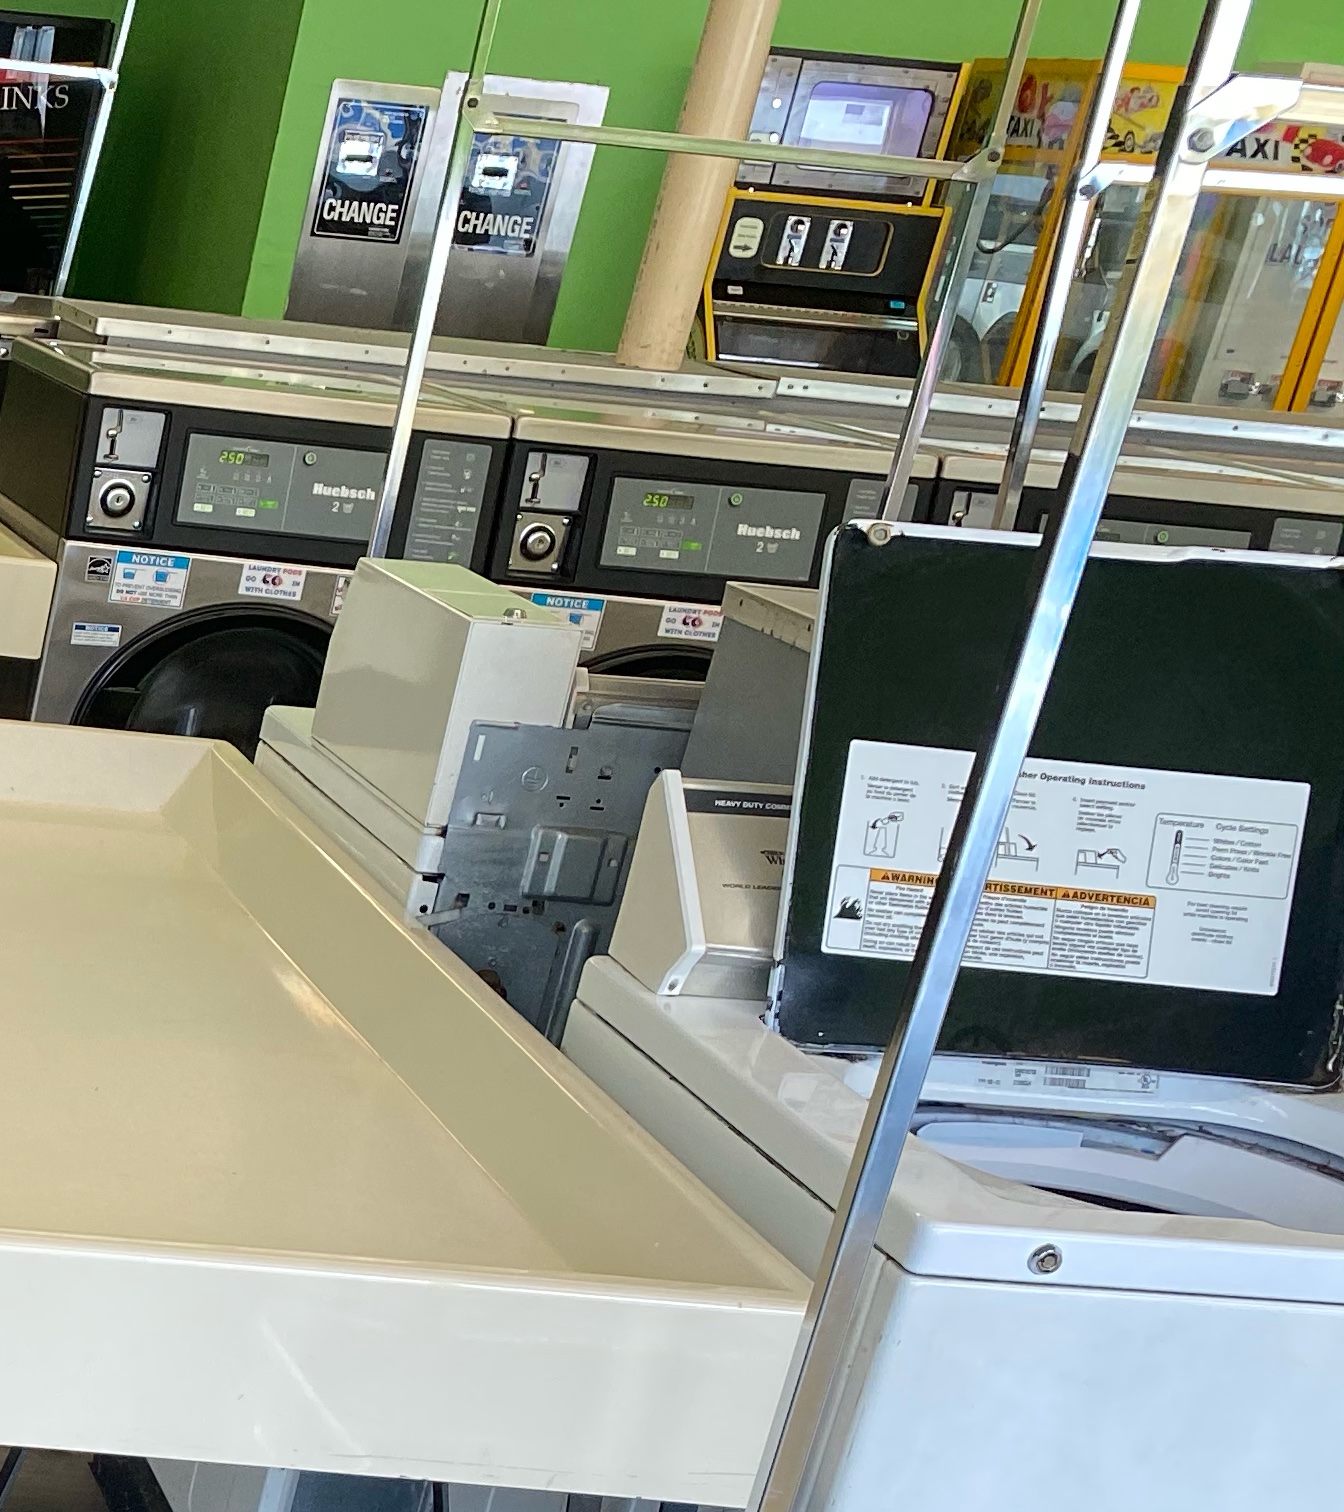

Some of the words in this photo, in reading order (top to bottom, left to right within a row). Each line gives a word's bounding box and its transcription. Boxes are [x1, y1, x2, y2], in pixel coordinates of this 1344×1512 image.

[1226, 137, 1280, 161] AXI
[322, 198, 399, 226] CHANGE
[457, 210, 534, 239] CHANGE
[313, 482, 376, 500] Huebsch
[331, 502, 340, 513] 2
[737, 523, 801, 541] Huebsch
[755, 542, 764, 553] 2
[132, 554, 176, 567] NOTICE
[248, 564, 282, 573] LAUNDRY
[282, 567, 303, 576] PODS
[245, 586, 263, 594] WITH
[264, 588, 297, 597] CLOTHES
[546, 596, 589, 610] NOTICE
[665, 628, 683, 636] WITH
[1040, 772, 1086, 785] Operating
[715, 799, 741, 808] HEAVY
[742, 801, 764, 809] DUTY
[1159, 817, 1205, 829] Temperature
[1216, 823, 1237, 832] Cycle
[1238, 825, 1269, 835] Settings
[985, 883, 1056, 898] RTISSEMENT
[1071, 890, 1150, 906] ADVERTENCIA
